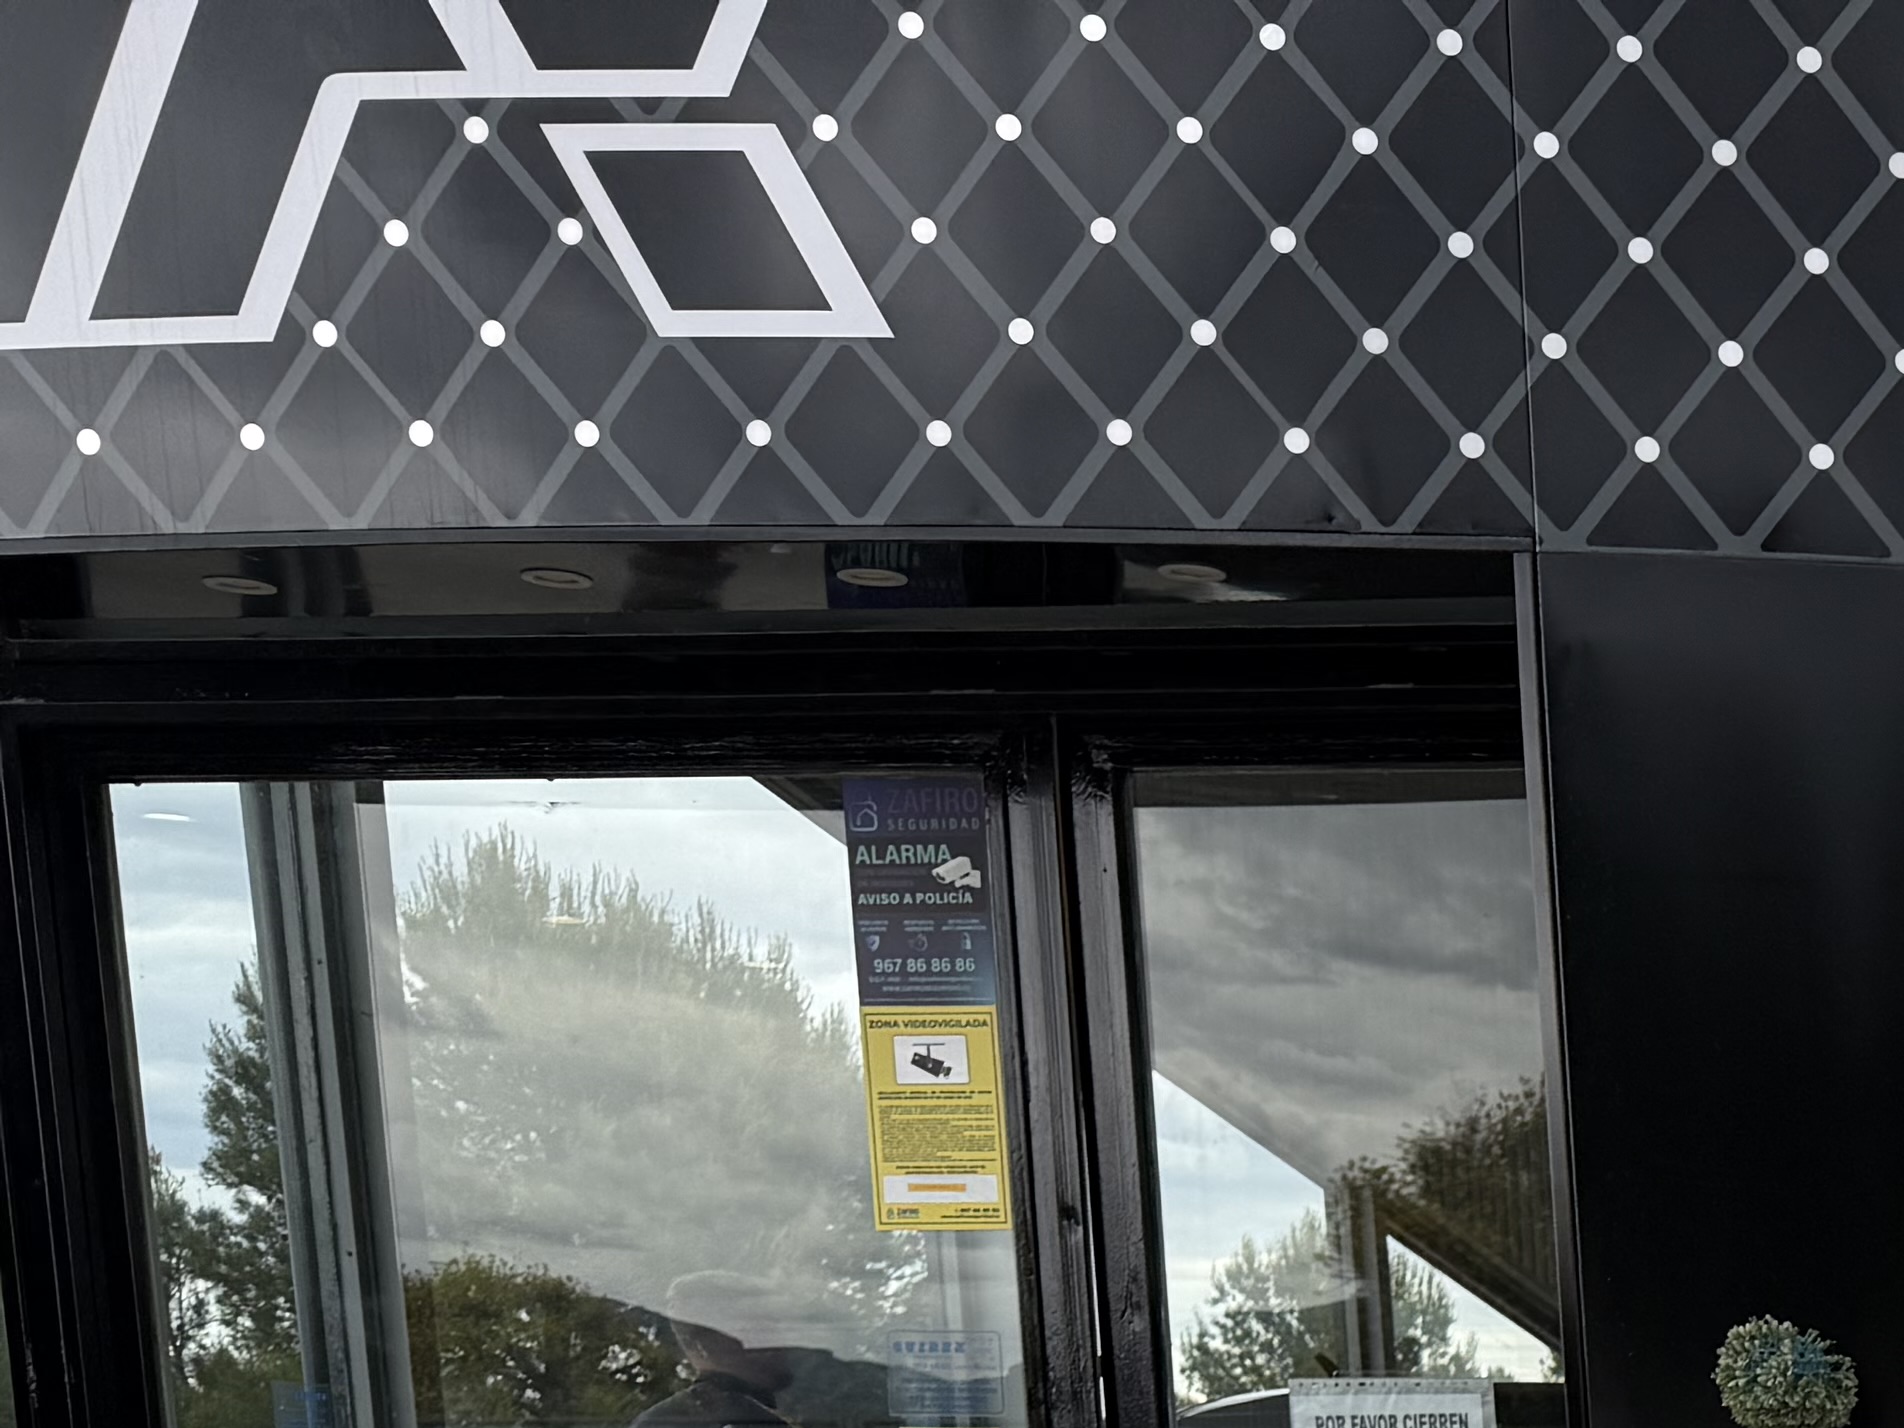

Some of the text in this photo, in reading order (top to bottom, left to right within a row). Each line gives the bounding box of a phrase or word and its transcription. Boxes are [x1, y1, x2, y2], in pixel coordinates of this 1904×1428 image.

[887, 787, 979, 814] ZAFIRO
[887, 818, 980, 831] SEGURIDAD
[855, 844, 952, 865] ALARMA
[858, 890, 973, 905] AVISO A POLICÍA
[873, 957, 976, 973] 967 86 86 86
[868, 1019, 989, 1029] ZONA VIDEOVIGILADA
